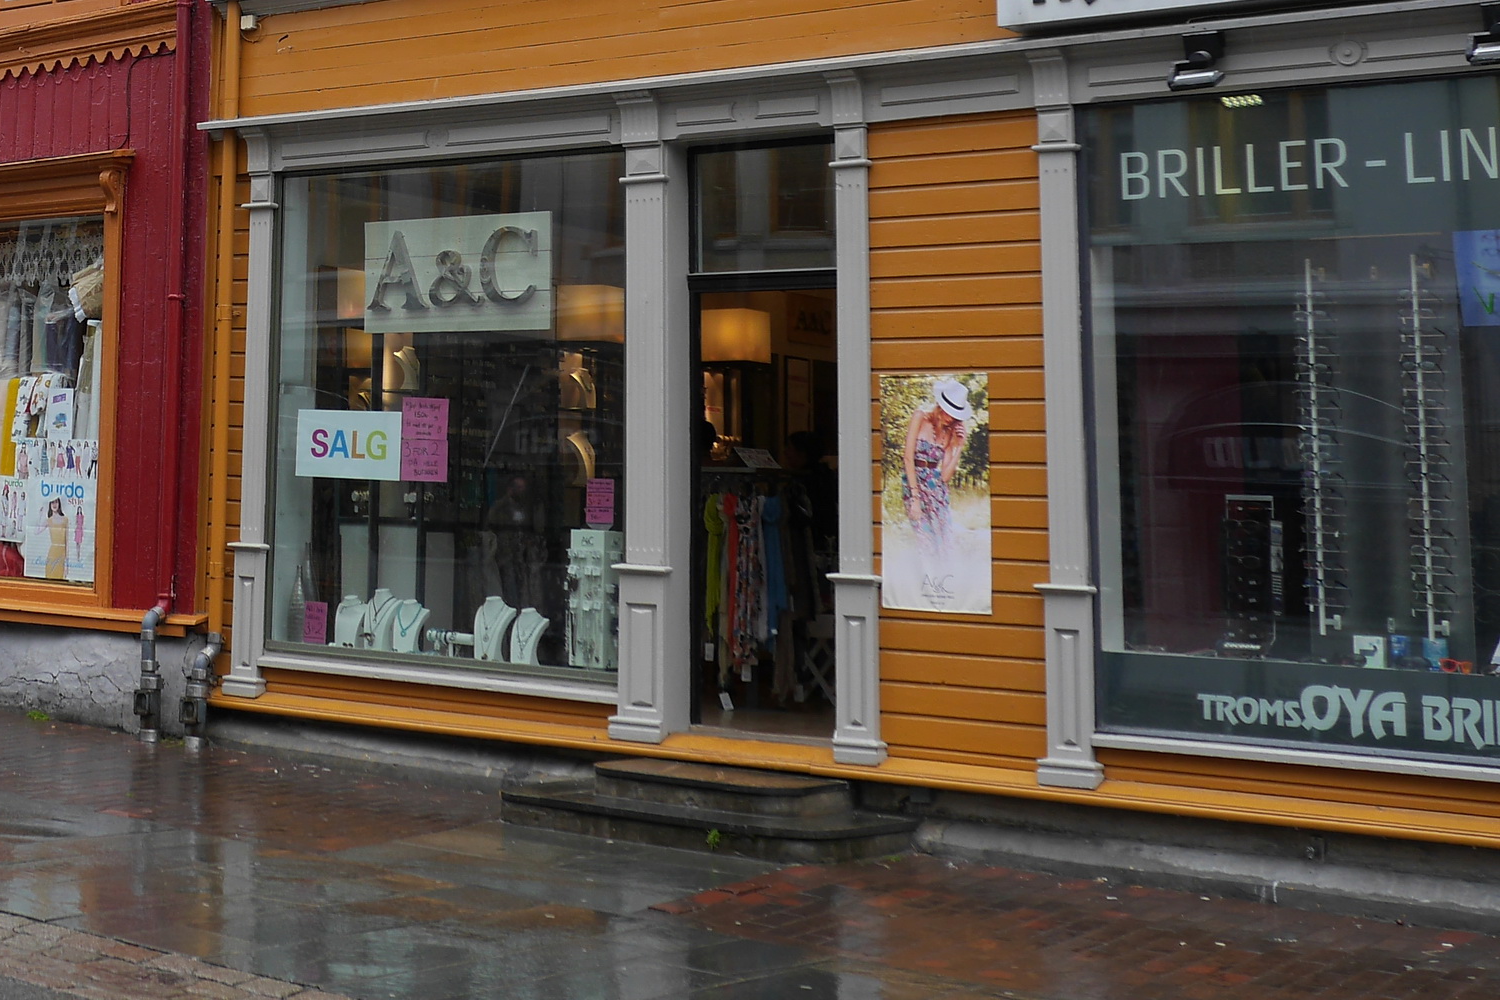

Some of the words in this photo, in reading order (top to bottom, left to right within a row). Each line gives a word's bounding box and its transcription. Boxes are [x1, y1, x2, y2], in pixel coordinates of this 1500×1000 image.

[1120, 137, 1349, 201] BRILLER
[367, 225, 539, 312] A&C
[310, 428, 388, 460] SALG
[403, 441, 412, 458] 3
[412, 447, 429, 456] FOR
[430, 441, 440, 456] 2
[4, 479, 23, 488] burda
[41, 480, 85, 499] burda
[67, 497, 84, 508] style
[921, 574, 955, 594] A&C
